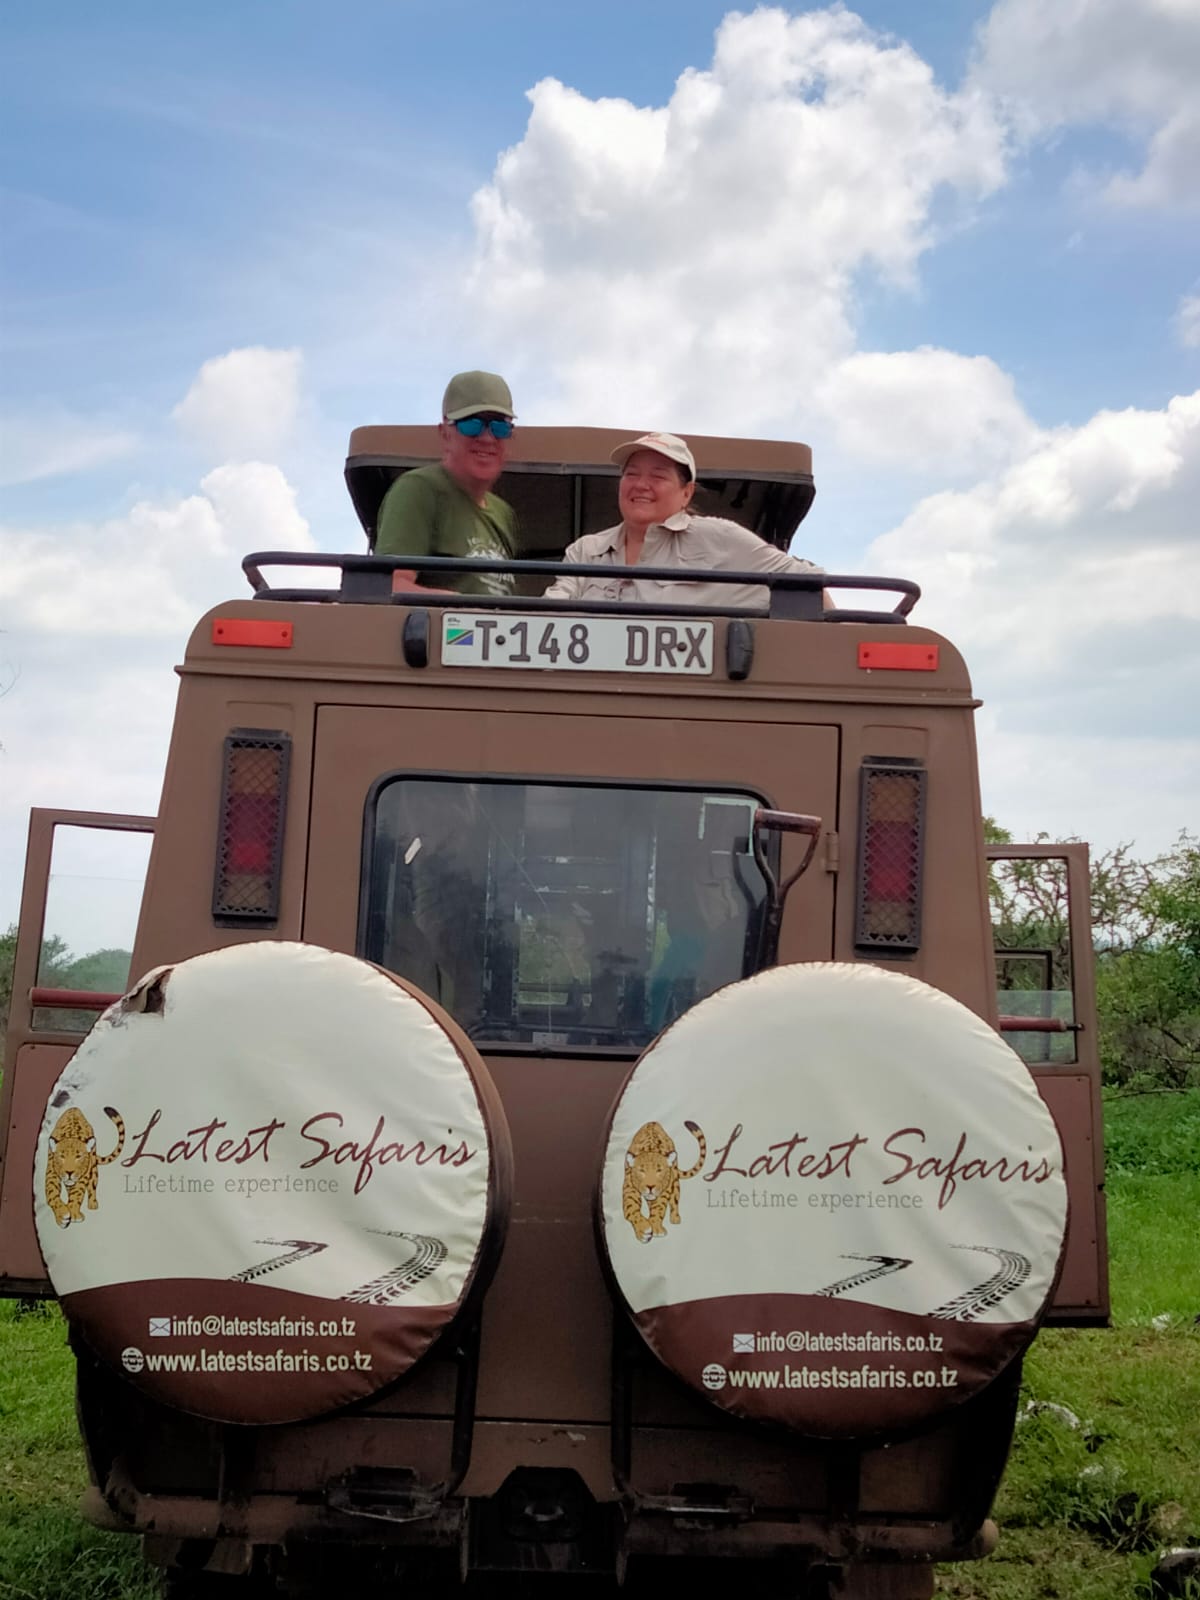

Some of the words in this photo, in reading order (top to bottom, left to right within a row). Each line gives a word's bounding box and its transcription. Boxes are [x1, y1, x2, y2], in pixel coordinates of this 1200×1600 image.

[121, 1109, 285, 1168] Latest
[299, 1112, 477, 1195] Safaris
[703, 1124, 868, 1181] Latest
[882, 1128, 1054, 1210] Safaris
[123, 1175, 215, 1194] Lifetime
[224, 1175, 339, 1198] experience
[706, 1189, 798, 1208] Lifetime
[807, 1190, 923, 1213] experience
[172, 1315, 356, 1338] info@latestsafaris.co.tz
[756, 1331, 943, 1354] info@latestsafaris.co.tz
[146, 1349, 372, 1373] www.latestsafaris.co.tz
[729, 1365, 958, 1390] www.latestsafaris.co.tz
